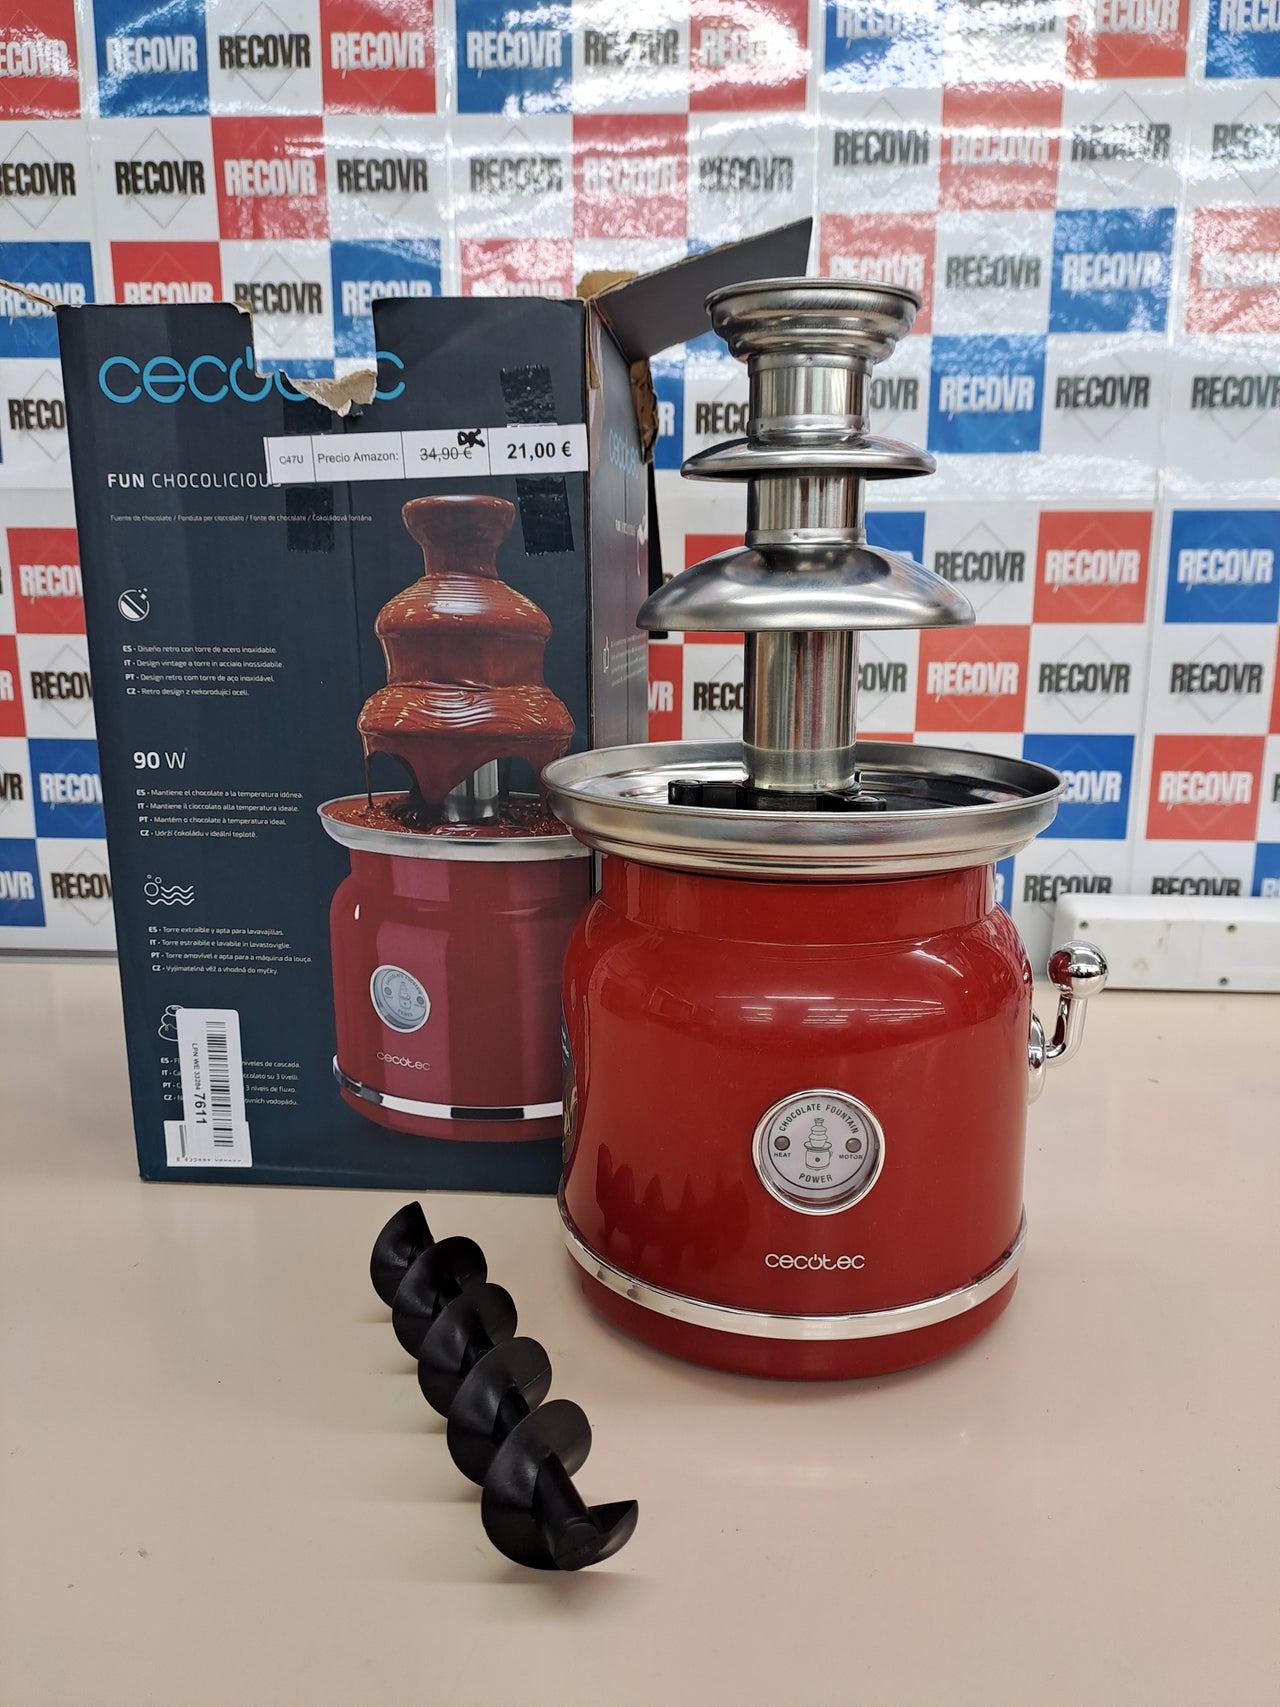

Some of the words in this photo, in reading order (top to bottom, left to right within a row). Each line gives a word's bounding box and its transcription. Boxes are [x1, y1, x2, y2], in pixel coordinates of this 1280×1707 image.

[0, 39, 68, 75] ECOVR
[105, 36, 198, 72] RECOVR
[219, 34, 310, 69] RECOVR
[330, 32, 425, 69] RECOVR
[466, 31, 562, 68] RECOVR
[834, 129, 929, 166] RECOVR
[951, 128, 1050, 165] RECOVR
[115, 161, 205, 195] RECOVR
[224, 159, 317, 195] RECOVR
[337, 158, 428, 192] RECOVR
[946, 255, 1041, 288] RECOVR
[1061, 252, 1164, 290] RECOVR
[234, 281, 322, 315] RECOVR
[98, 346, 405, 404] cecoc
[939, 375, 1035, 412] RECOVR
[1055, 376, 1150, 409] RECOVR
[8, 399, 65, 430] RECO
[279, 453, 304, 465] C47U
[317, 452, 350, 464] Precio
[353, 450, 399, 464] Amazon:
[419, 447, 459, 462] 34,90
[463, 447, 472, 460] €
[507, 442, 555, 461] 21,00
[561, 441, 572, 457] €
[107, 473, 145, 488] FUN
[152, 472, 281, 488] CHOCOLICIOU
[19, 564, 83, 597] RECO
[934, 551, 1026, 583] RECOVR
[1044, 549, 1141, 584] RECOVR
[1178, 549, 1273, 584] RECOVR
[137, 660, 160, 668] Design
[141, 674, 164, 682] Design
[927, 662, 1019, 695] RECOVR
[1039, 663, 1131, 693] RECOVR
[1170, 663, 1263, 694] RECOVR
[30, 671, 93, 699] RECO
[162, 688, 184, 696] design
[39, 773, 103, 803] RECO
[1159, 771, 1253, 804] RECOVR
[377, 1051, 430, 1071] cecotec
[194, 1092, 208, 1125] 7611
[779, 1103, 821, 1132] CHOCOLATE
[825, 1104, 860, 1134] FOUNTAIN
[798, 1172, 833, 1184] POWER
[764, 1253, 865, 1271] cecotec
